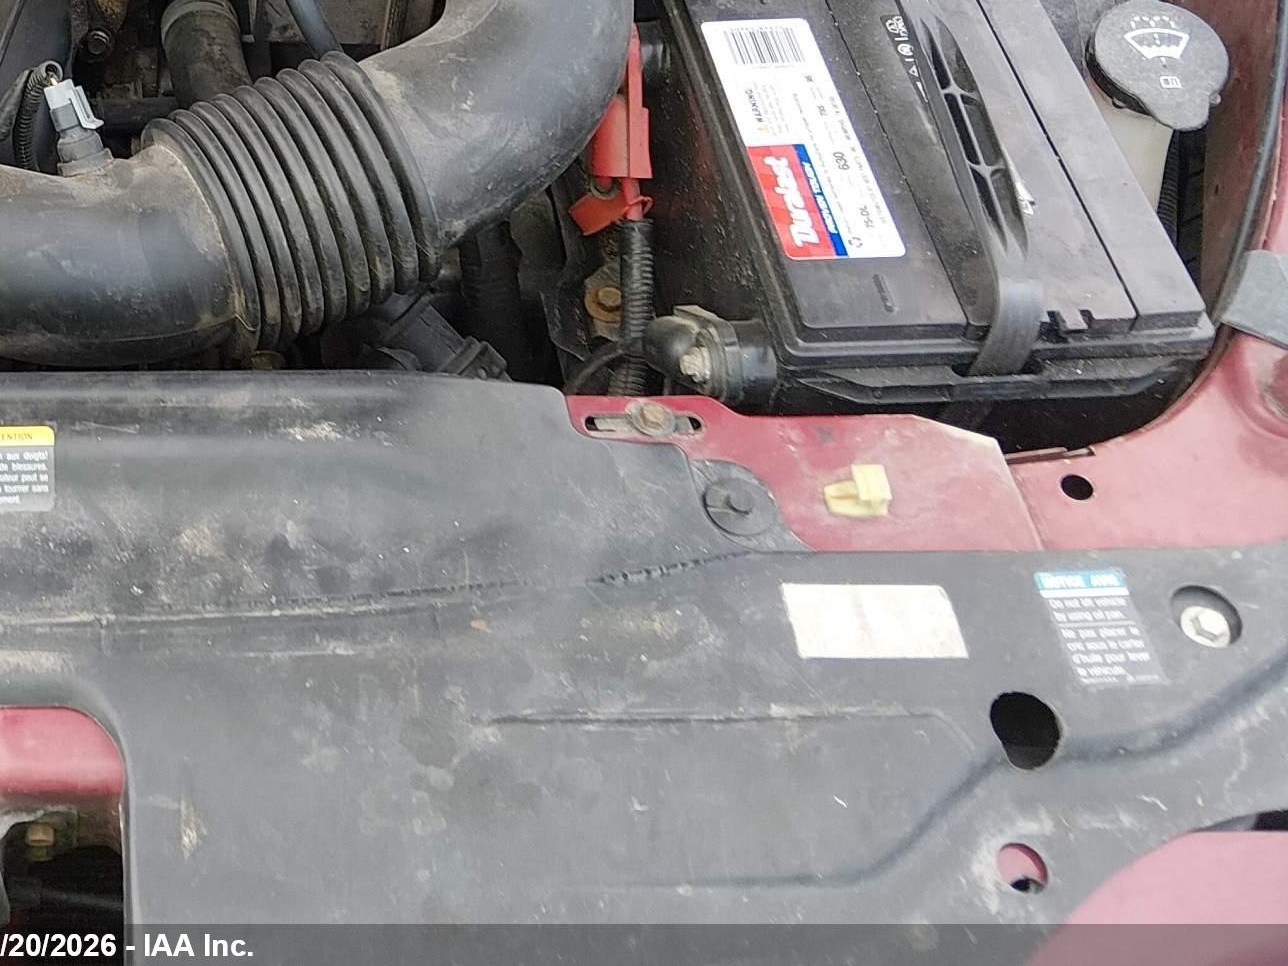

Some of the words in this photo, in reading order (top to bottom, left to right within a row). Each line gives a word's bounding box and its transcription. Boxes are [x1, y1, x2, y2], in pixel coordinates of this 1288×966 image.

[744, 89, 764, 124] WARNING
[832, 151, 850, 171] 630
[763, 156, 821, 248] Duralast
